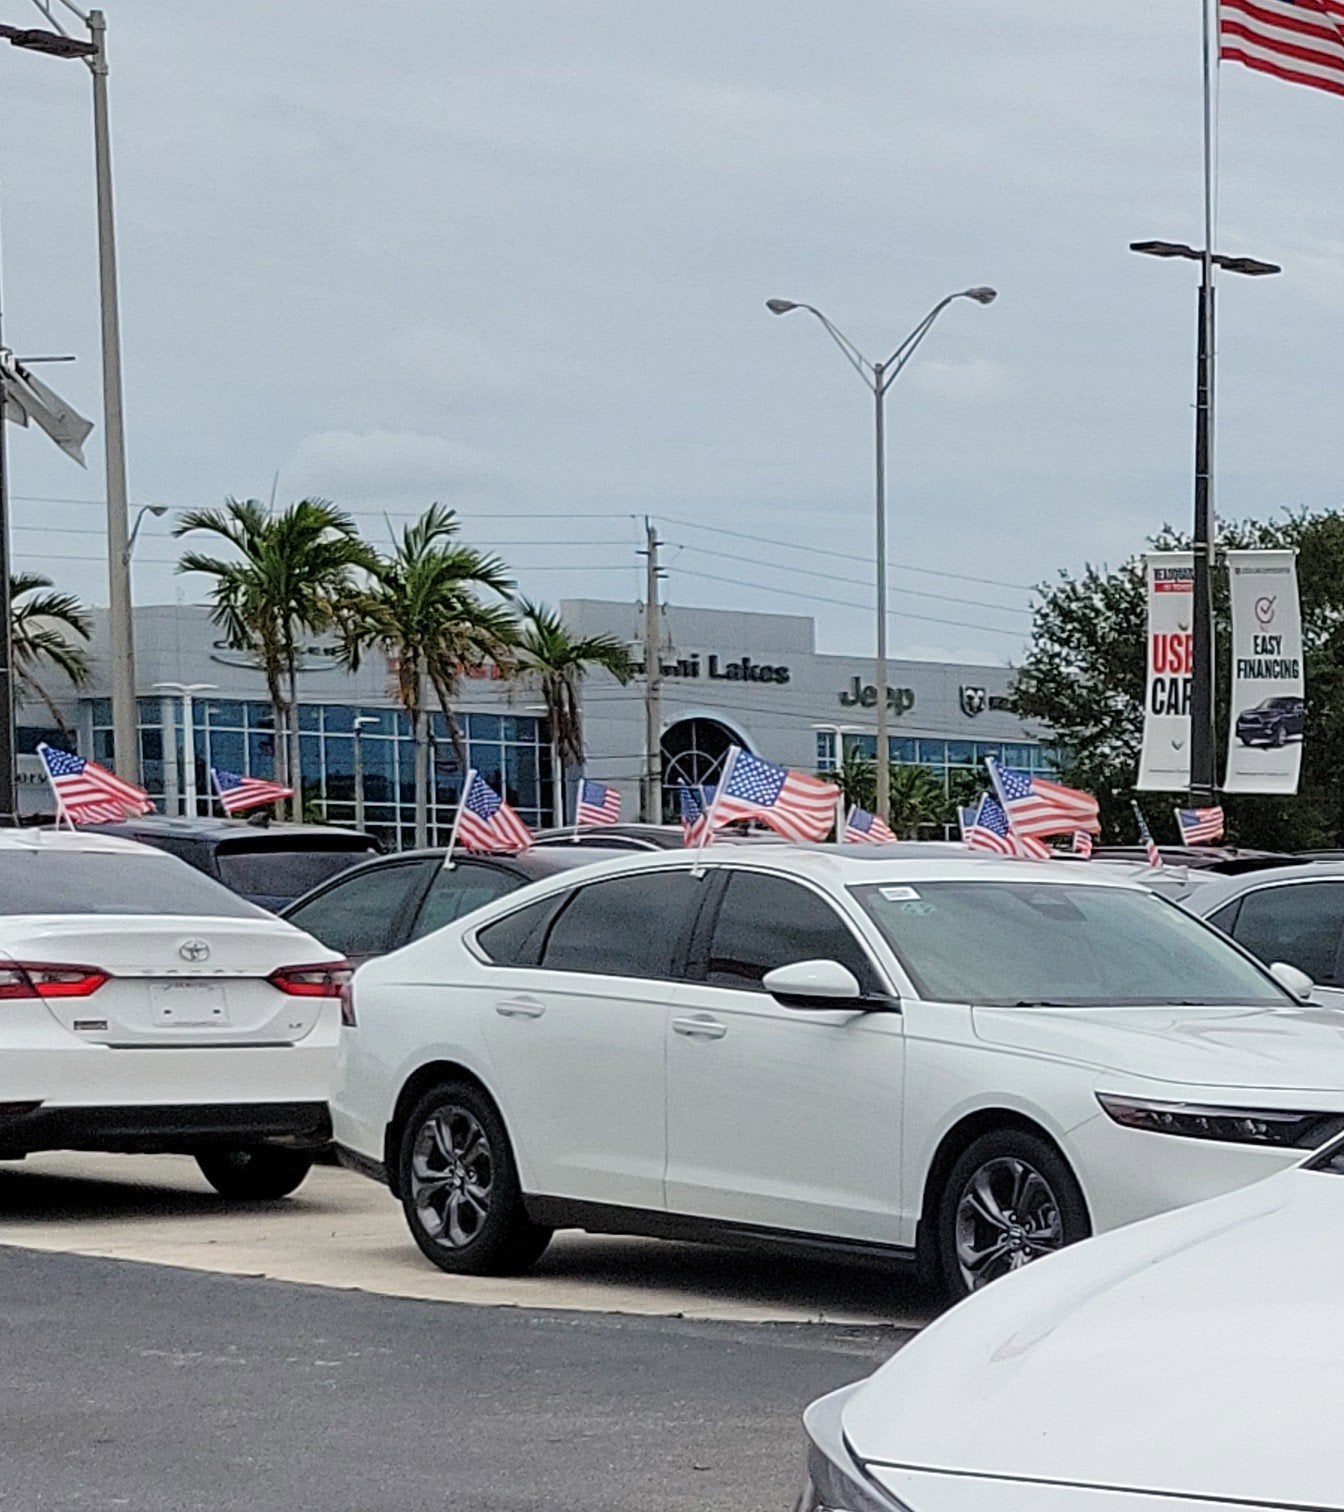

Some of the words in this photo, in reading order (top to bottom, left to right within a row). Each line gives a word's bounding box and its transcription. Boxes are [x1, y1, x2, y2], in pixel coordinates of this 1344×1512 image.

[1153, 633, 1193, 674] USE
[1253, 634, 1282, 655] EASY
[708, 654, 790, 684] Lakes
[1236, 658, 1300, 680] FINANCING
[838, 675, 915, 717] Jep
[1151, 676, 1192, 716] CAR
